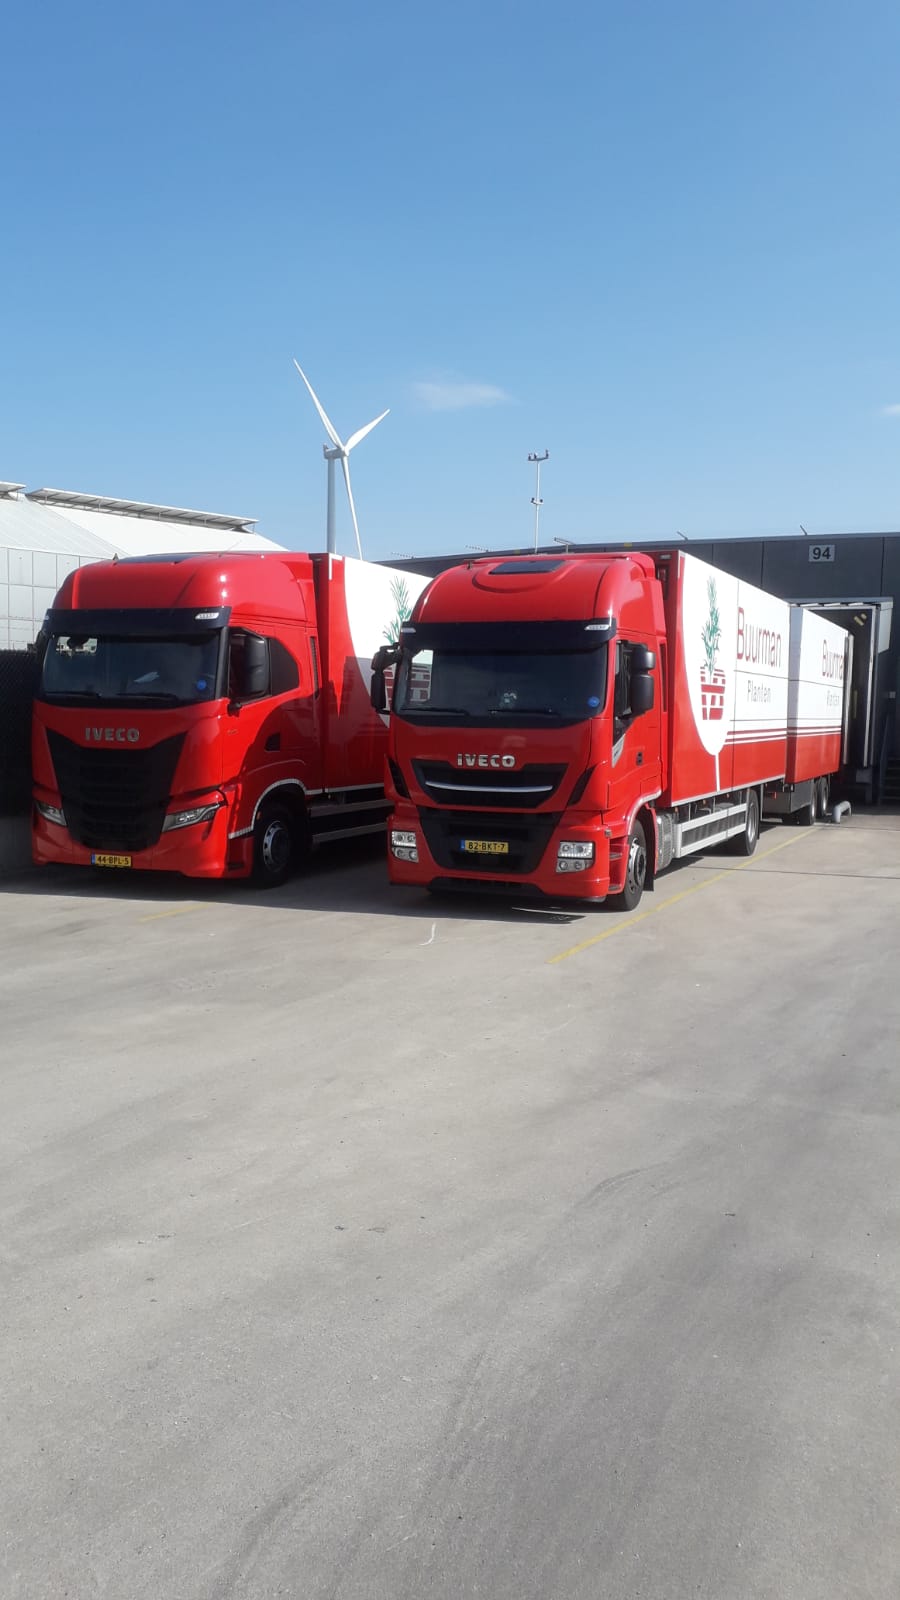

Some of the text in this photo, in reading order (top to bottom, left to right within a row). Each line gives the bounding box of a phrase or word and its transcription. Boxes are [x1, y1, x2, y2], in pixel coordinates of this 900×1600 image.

[812, 546, 831, 560] 94
[737, 606, 782, 668] Buurman
[747, 679, 771, 703] Planten
[85, 727, 140, 743] IVECO
[457, 753, 516, 768] IVECO
